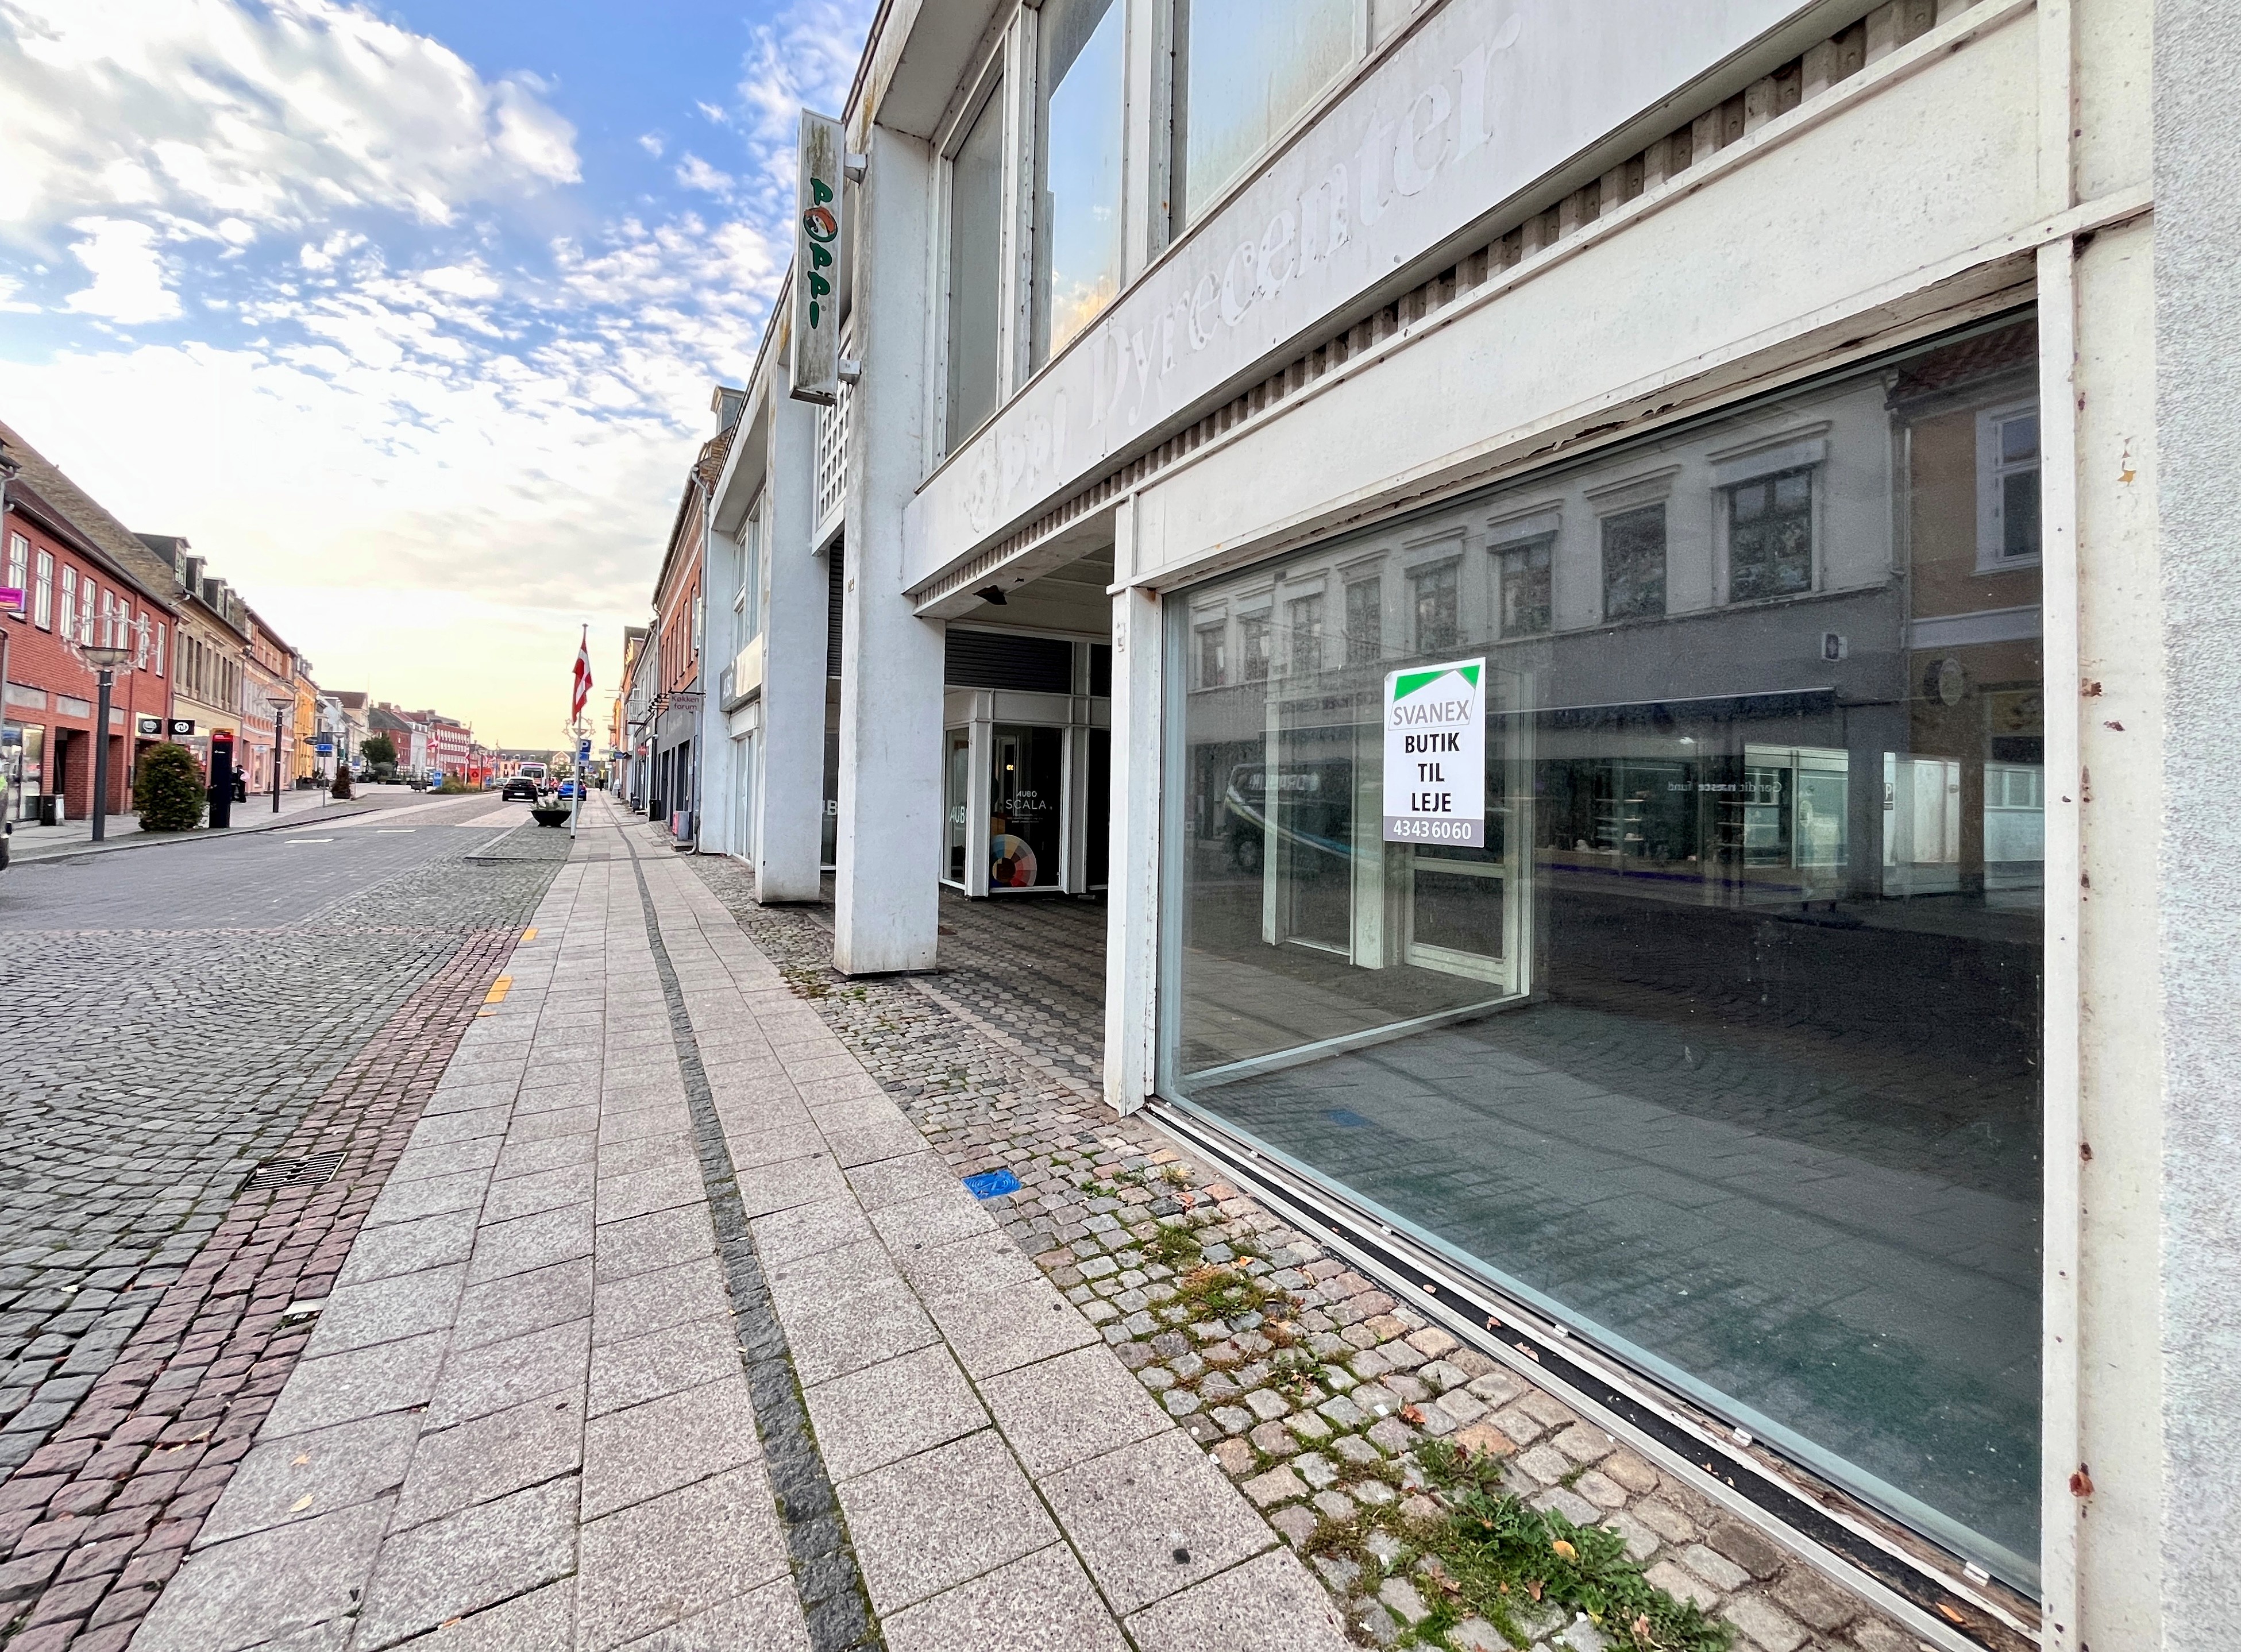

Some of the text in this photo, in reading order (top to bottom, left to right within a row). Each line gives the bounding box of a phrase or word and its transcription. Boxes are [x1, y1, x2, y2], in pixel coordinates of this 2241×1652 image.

[1087, 13, 1522, 431] Dyrecenter
[1393, 699, 1469, 726] SVANEX
[1405, 732, 1460, 754] BUTIK
[1418, 763, 1445, 782] TIL
[1005, 799, 1047, 810] SCALA
[1411, 793, 1452, 812] LEJE
[948, 805, 968, 824] AUB
[1393, 820, 1472, 840] 43436060
